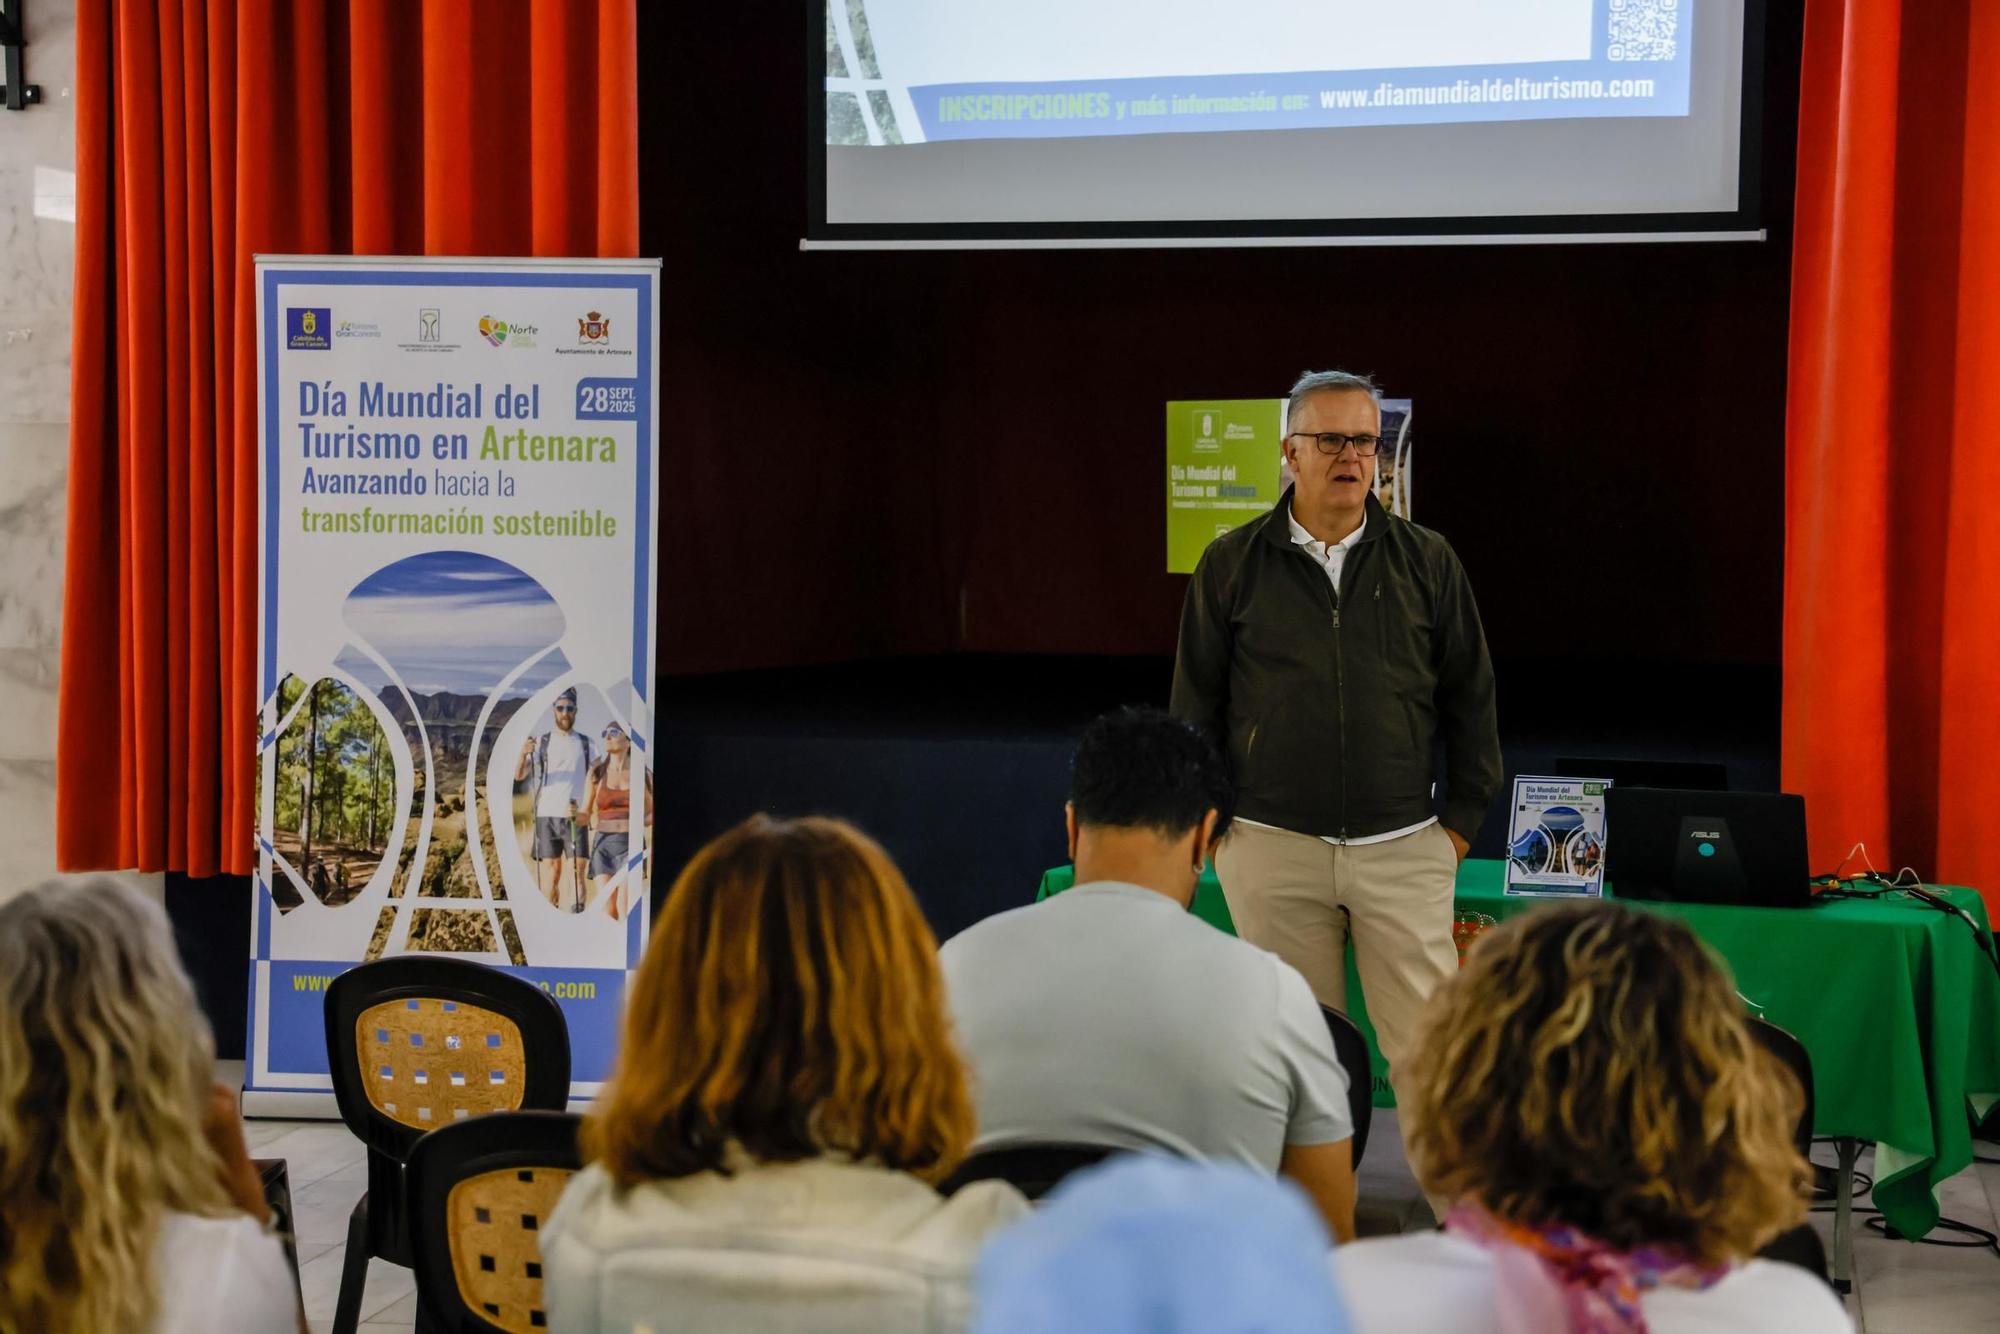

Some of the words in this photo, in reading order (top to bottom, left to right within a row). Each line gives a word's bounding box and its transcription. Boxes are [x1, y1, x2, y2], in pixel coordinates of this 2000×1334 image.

[938, 92, 1111, 123] INSCRIPCIONES
[1115, 99, 1126, 120] y
[1131, 94, 1168, 116] más
[1172, 91, 1277, 114] información
[1320, 76, 1655, 109] www.diamundialdelturismo.com
[508, 324, 538, 335] Norte
[555, 348, 597, 356] Ayuntamiento
[300, 381, 347, 417] Día
[360, 382, 481, 418] Mundial
[495, 384, 539, 419] del
[580, 387, 608, 412] 28
[609, 387, 636, 400] SEPT.
[609, 400, 635, 413] 2025
[299, 423, 421, 459] Turismo
[432, 434, 468, 460] en
[480, 426, 616, 462] Artenara
[302, 467, 426, 495] Avanzando
[435, 469, 489, 496] hacia
[498, 470, 515, 496] la
[302, 507, 484, 535] transformación
[494, 510, 616, 537] sostenible
[1690, 831, 1720, 839] ASUS
